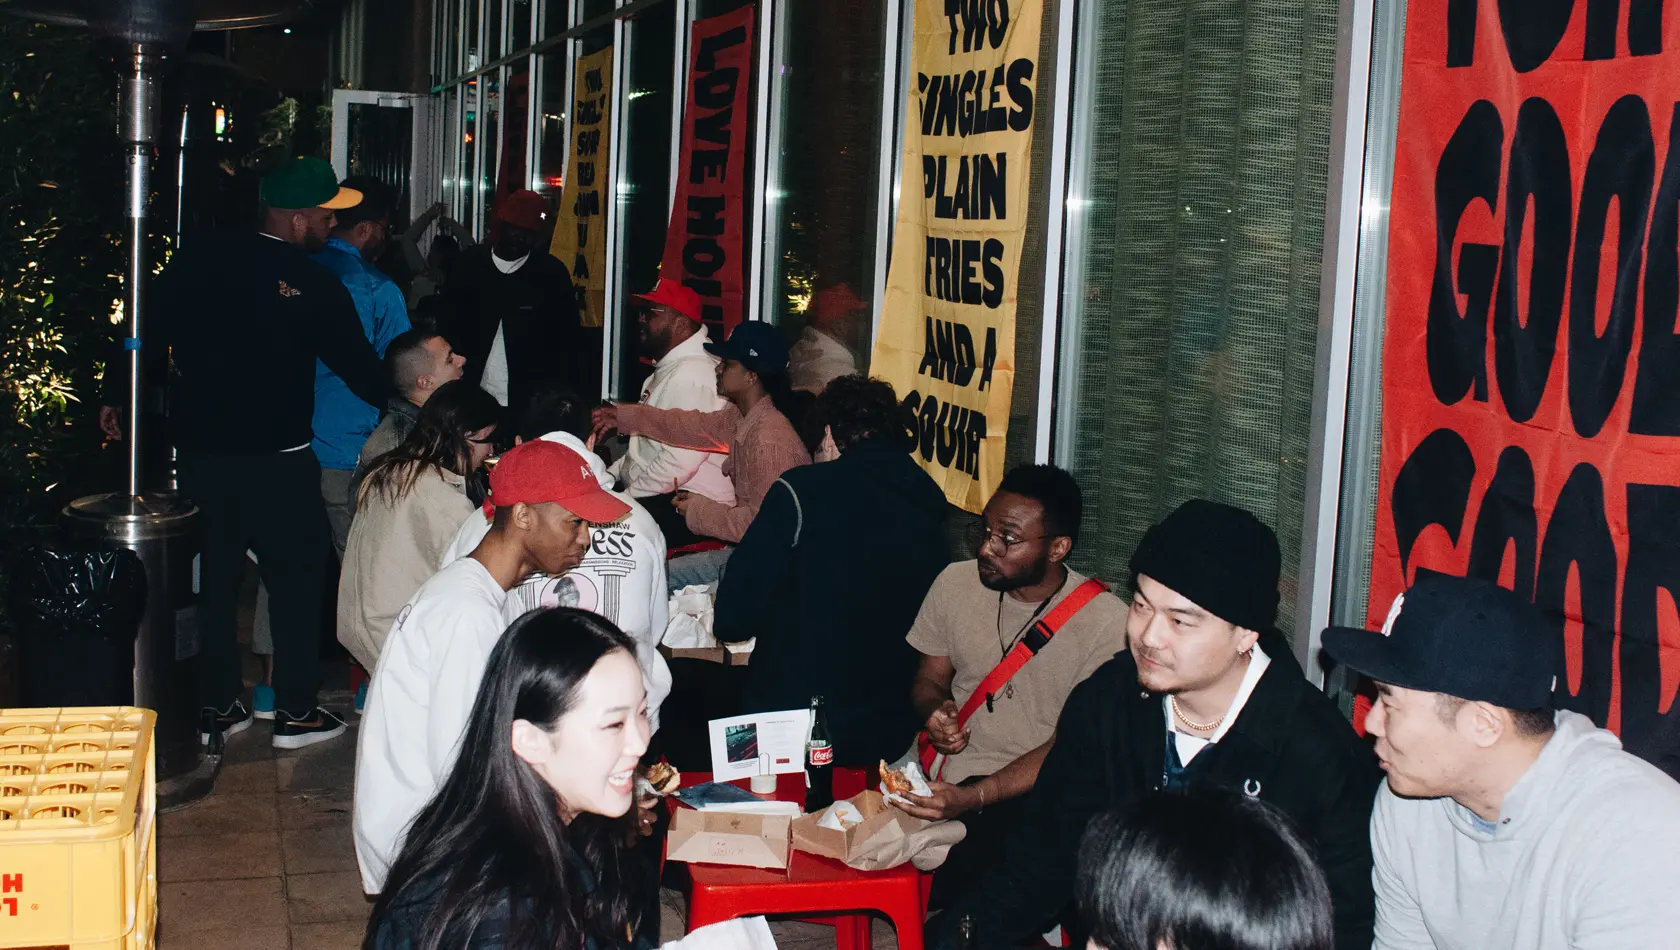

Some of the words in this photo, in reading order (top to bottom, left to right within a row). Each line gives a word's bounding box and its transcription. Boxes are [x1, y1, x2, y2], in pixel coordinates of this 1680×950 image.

[944, 0, 1009, 55] TWO
[689, 25, 746, 184] LOVE
[922, 152, 1006, 220] PLAIN
[925, 235, 1005, 309] FRIES
[918, 315, 976, 387] AND
[978, 327, 997, 391] A
